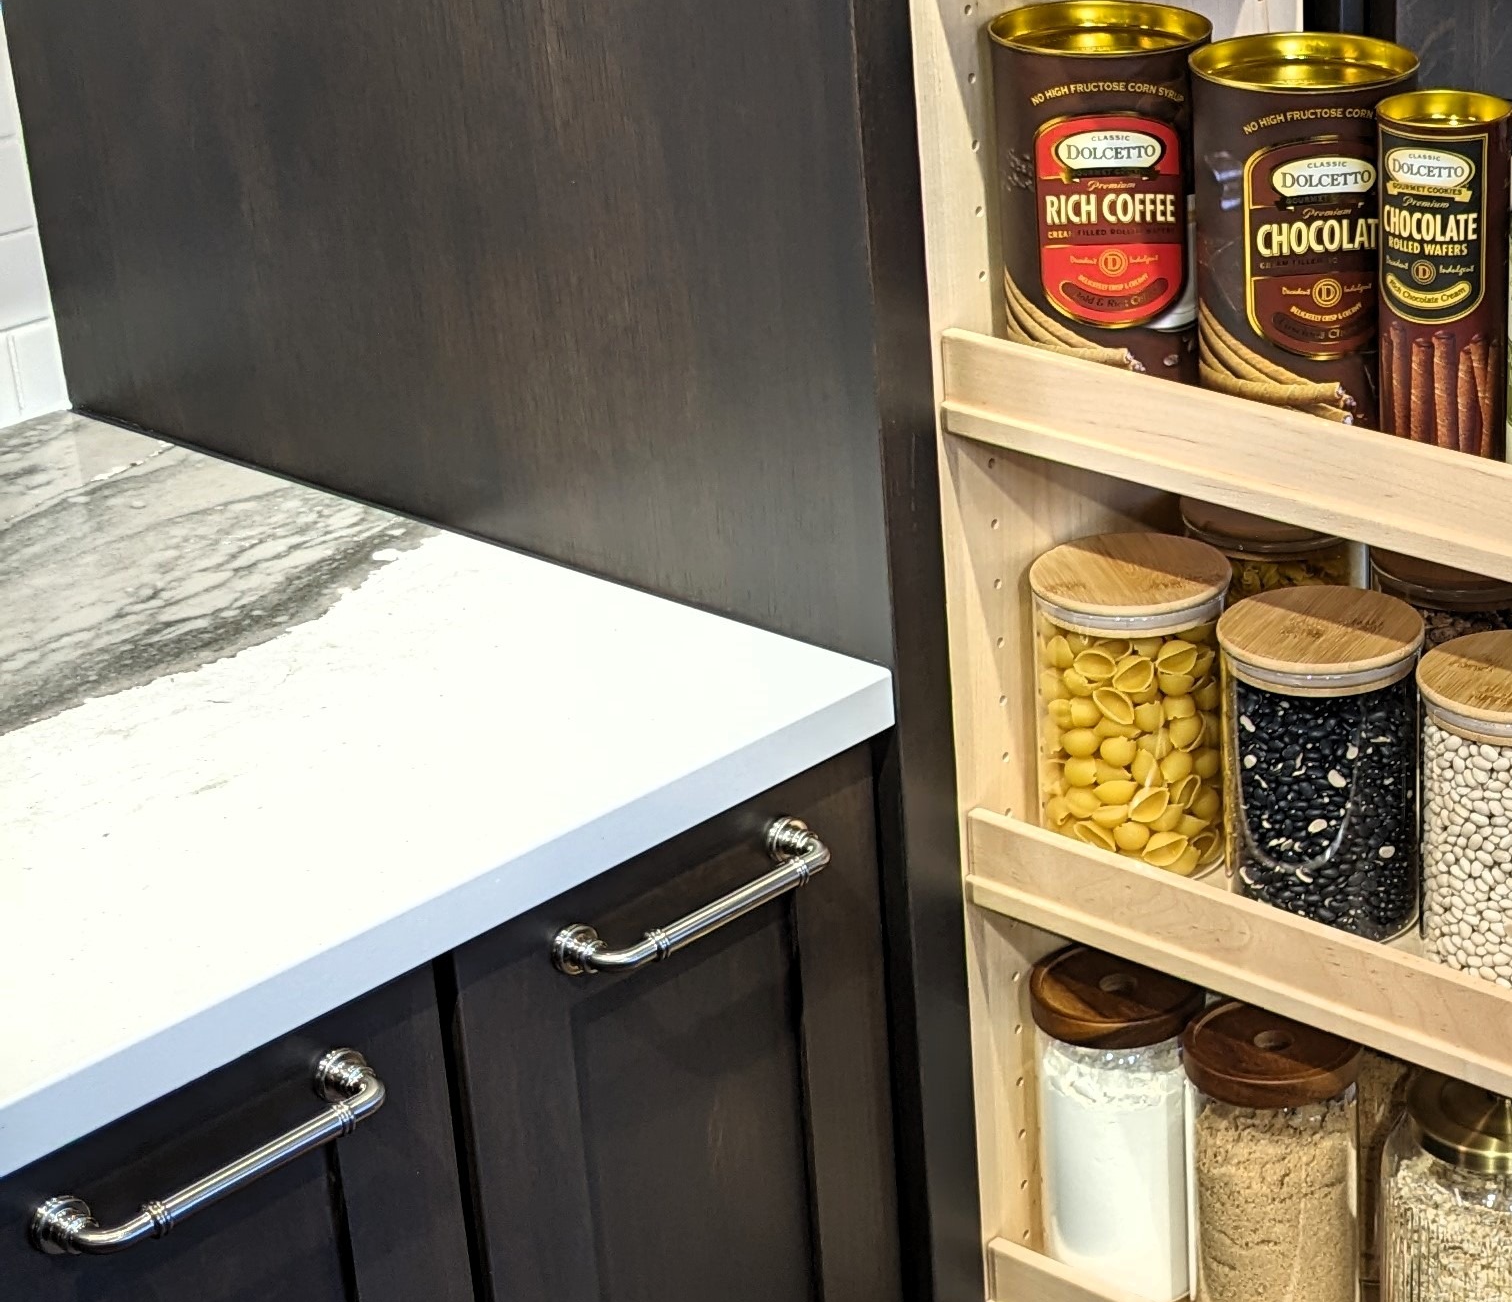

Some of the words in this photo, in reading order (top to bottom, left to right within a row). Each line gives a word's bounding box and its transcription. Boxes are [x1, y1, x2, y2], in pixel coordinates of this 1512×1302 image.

[1030, 93, 1045, 107] NO
[1045, 87, 1070, 100] HIGH
[1070, 82, 1127, 94] FRUCTOSE
[1127, 82, 1157, 94] CORN
[1243, 121, 1258, 135] NO
[1259, 114, 1285, 128] HIGH
[1286, 108, 1342, 122] FRUCTOSE
[1345, 108, 1373, 119] CORN
[1066, 144, 1156, 160] DOLCETTO
[1307, 161, 1347, 169] CLASSIC
[1392, 158, 1464, 178] DOLCETTO
[1087, 180, 1136, 191] Premium
[1281, 169, 1371, 188] DOLCETTO
[1392, 183, 1425, 193] GOURMET
[1427, 187, 1462, 195] COOKIES
[1045, 194, 1098, 225] RICH
[1102, 193, 1176, 224] COFFEE
[1402, 196, 1450, 209] Premium
[1302, 207, 1352, 219] Premium
[1384, 205, 1478, 242] CHOCOLATE
[1256, 218, 1378, 257] CHOCOLAT
[1388, 236, 1421, 254] ROLLED
[1423, 243, 1468, 256] WAFERS
[1441, 287, 1467, 302] Cream
